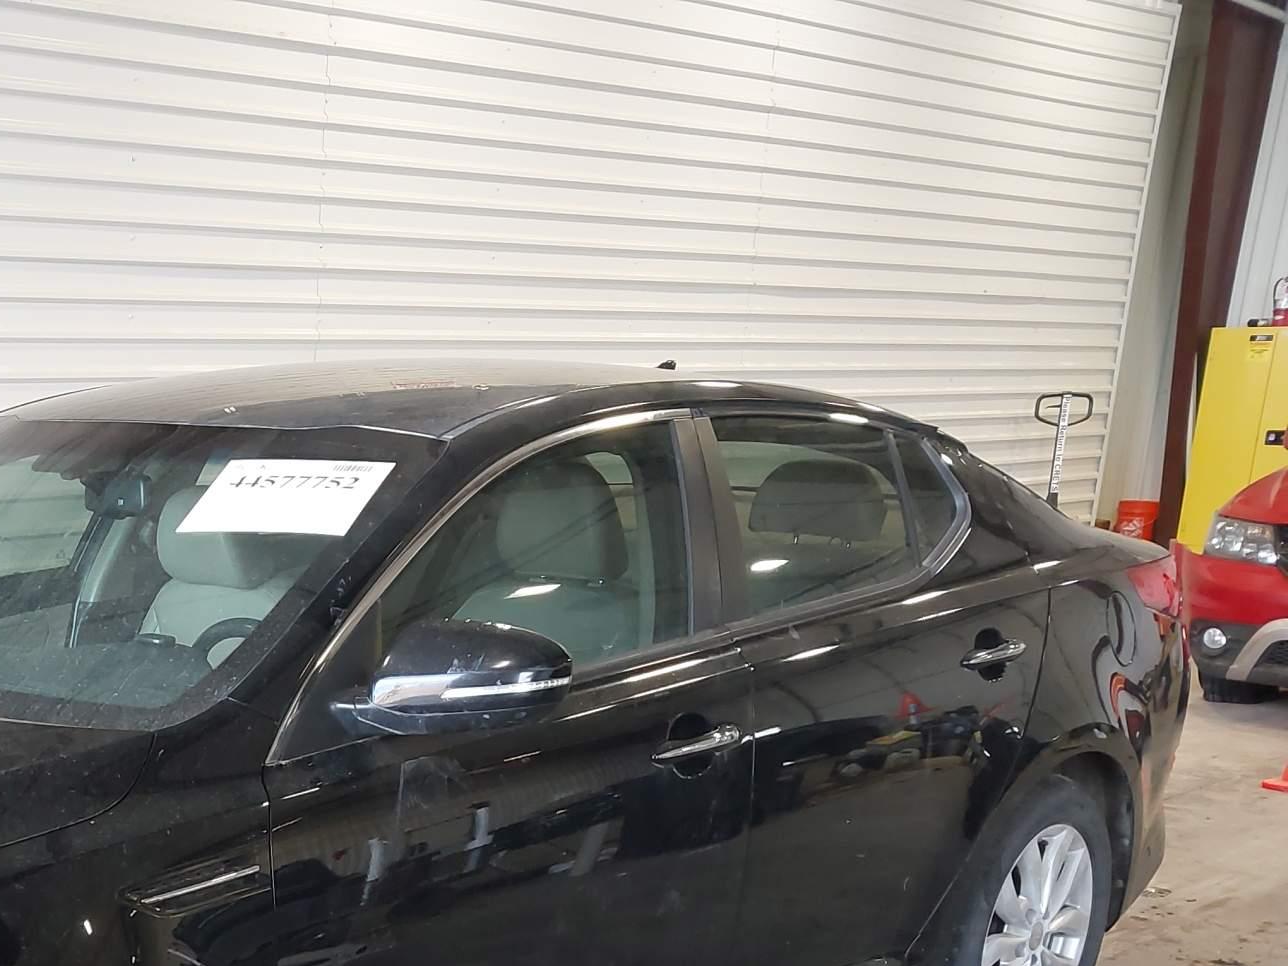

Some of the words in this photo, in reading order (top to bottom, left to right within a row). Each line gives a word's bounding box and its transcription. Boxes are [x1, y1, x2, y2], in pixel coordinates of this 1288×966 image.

[1061, 397, 1071, 423] Please
[1056, 425, 1067, 452] Return
[229, 475, 360, 489] 44577752
